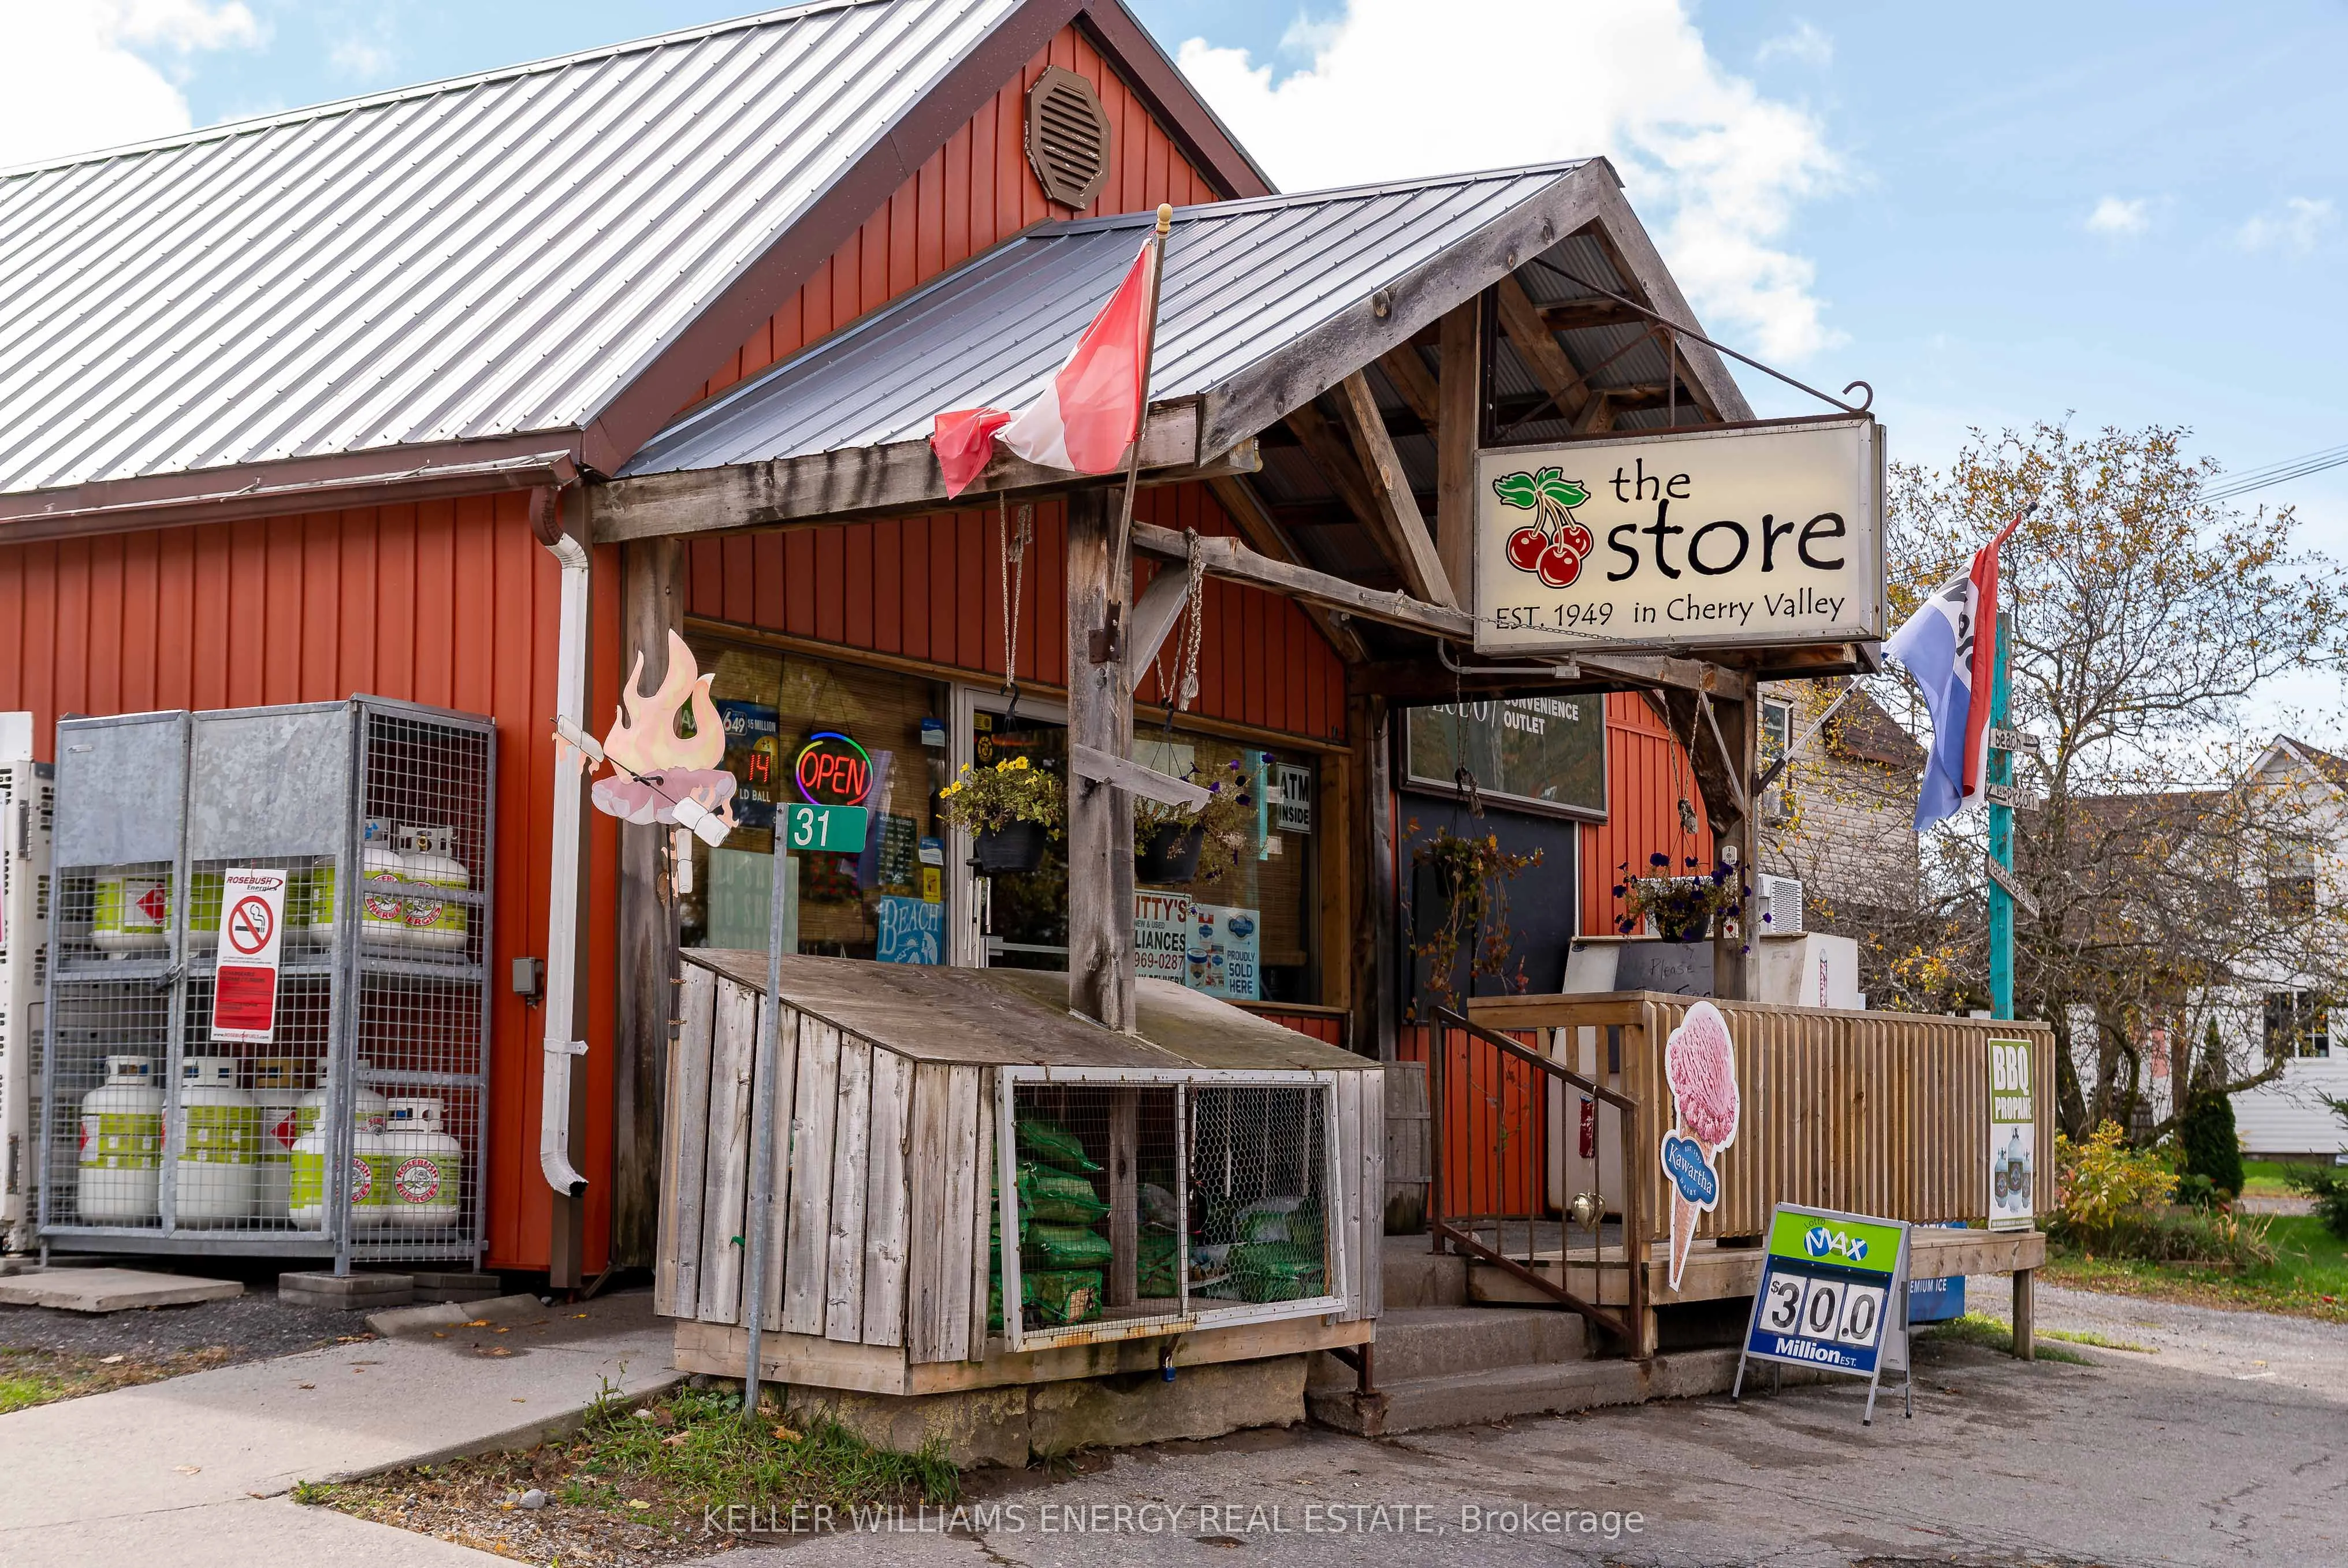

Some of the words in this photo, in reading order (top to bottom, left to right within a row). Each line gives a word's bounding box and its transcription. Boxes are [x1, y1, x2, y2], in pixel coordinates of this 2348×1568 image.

[1609, 458, 1690, 503] the
[1607, 499, 1845, 582] store
[1497, 606, 1545, 630] EST.
[1554, 602, 1613, 627] 1949
[1635, 602, 1656, 624] in
[1668, 593, 1754, 626] Cherry
[1765, 587, 1845, 621] Valley
[755, 720, 776, 732] MILLION
[1504, 710, 1545, 735] OUTLET
[1996, 730, 2021, 750] beach
[749, 754, 769, 783] 14
[801, 751, 865, 795] OPEN
[753, 790, 770, 802] BALL
[1279, 772, 1308, 802] ATM
[1279, 805, 1308, 825] INSIDE
[795, 808, 829, 847] 31
[226, 877, 272, 885] ROSEBUSH
[1136, 896, 1187, 922] ITTY'S
[879, 899, 939, 955] BEACH
[1135, 930, 1186, 952] LIANCES
[1227, 950, 1255, 962] PROUDLY
[1229, 963, 1253, 978] SOLD
[1650, 958, 1695, 981] Please
[1229, 979, 1253, 994] HERE
[1993, 1045, 2029, 1096] BBQ
[1995, 1097, 2031, 1119] PROPANE
[397, 1159, 438, 1178] ROSEBUSH
[1668, 1143, 1711, 1195] Kawartha
[396, 1183, 438, 1203] ENERGIES
[1804, 1218, 1826, 1229] Lotto
[1805, 1228, 1867, 1261] MAX
[1936, 1279, 1947, 1292] ICE
[1776, 1338, 1841, 1364] Million
[1840, 1357, 1856, 1367] EST.
